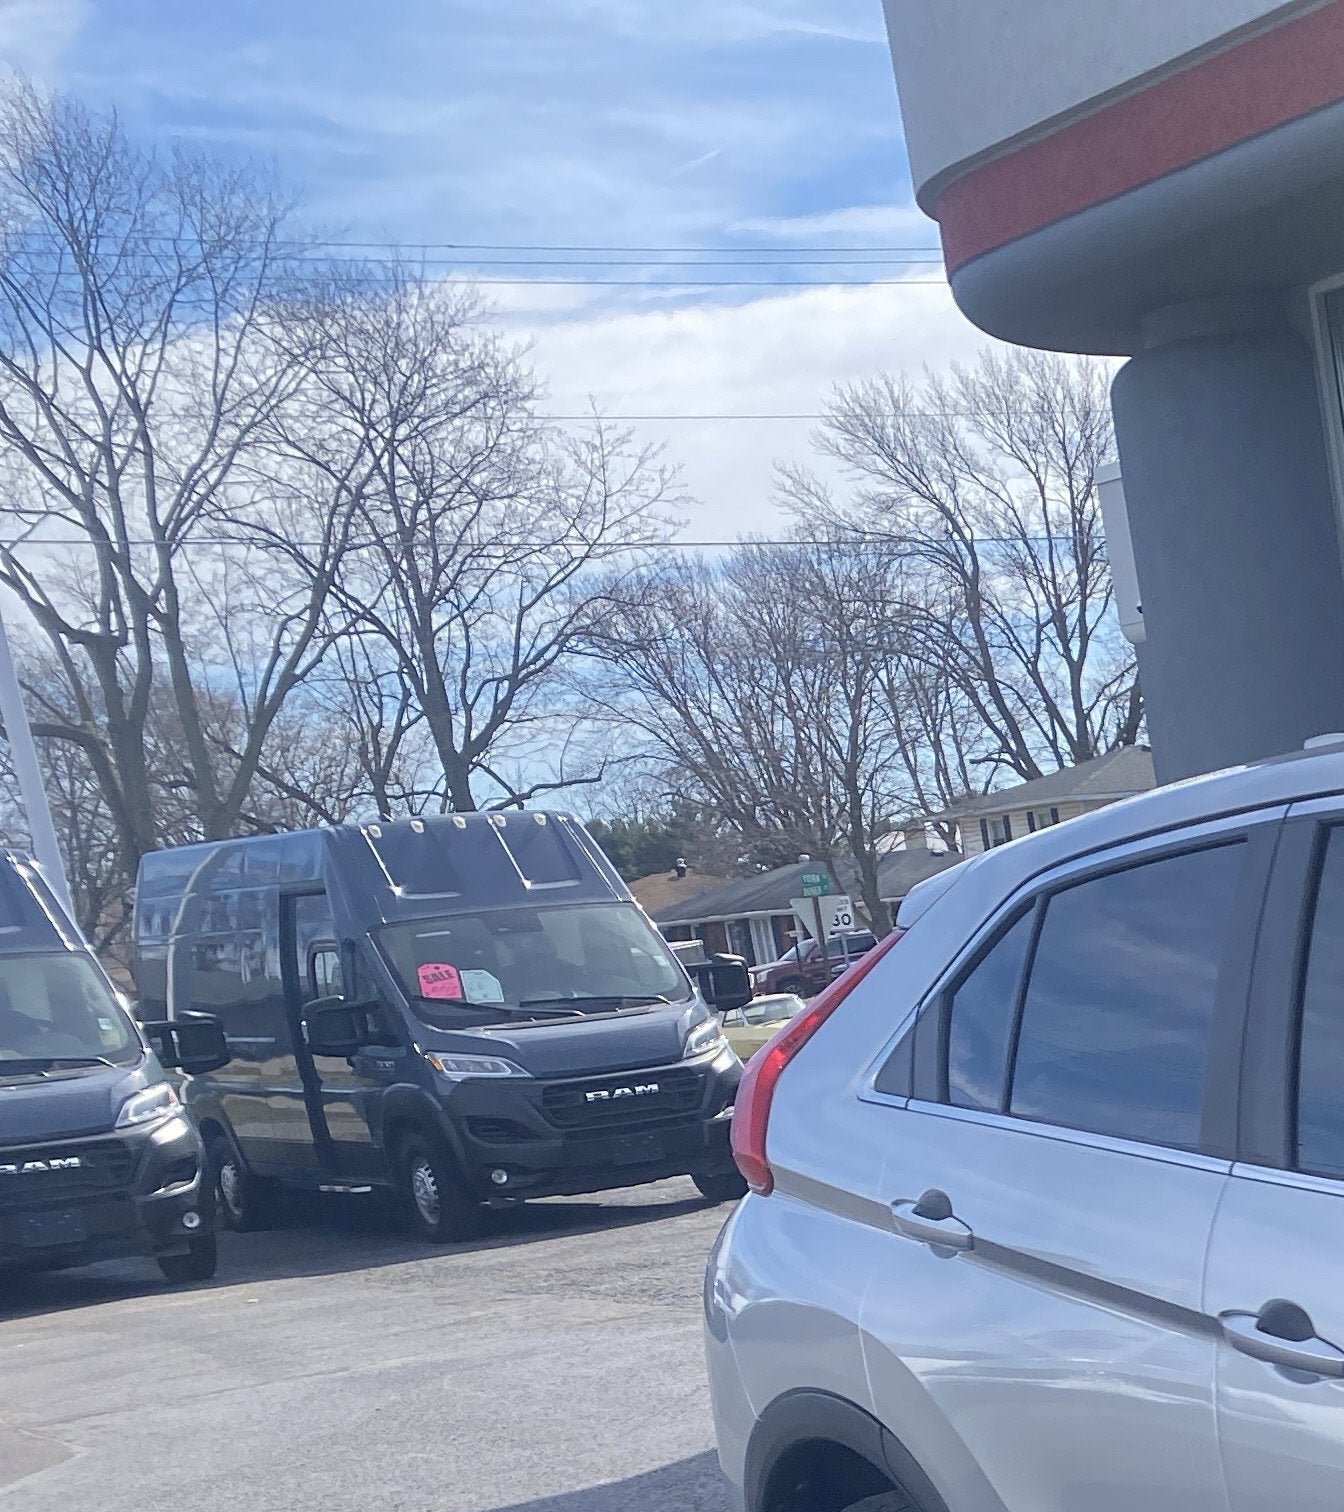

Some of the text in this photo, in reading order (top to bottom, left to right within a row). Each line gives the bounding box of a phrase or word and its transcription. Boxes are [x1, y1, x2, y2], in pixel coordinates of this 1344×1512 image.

[832, 913, 851, 927] 30
[422, 969, 455, 984] SALE
[585, 1083, 659, 1102] RAM
